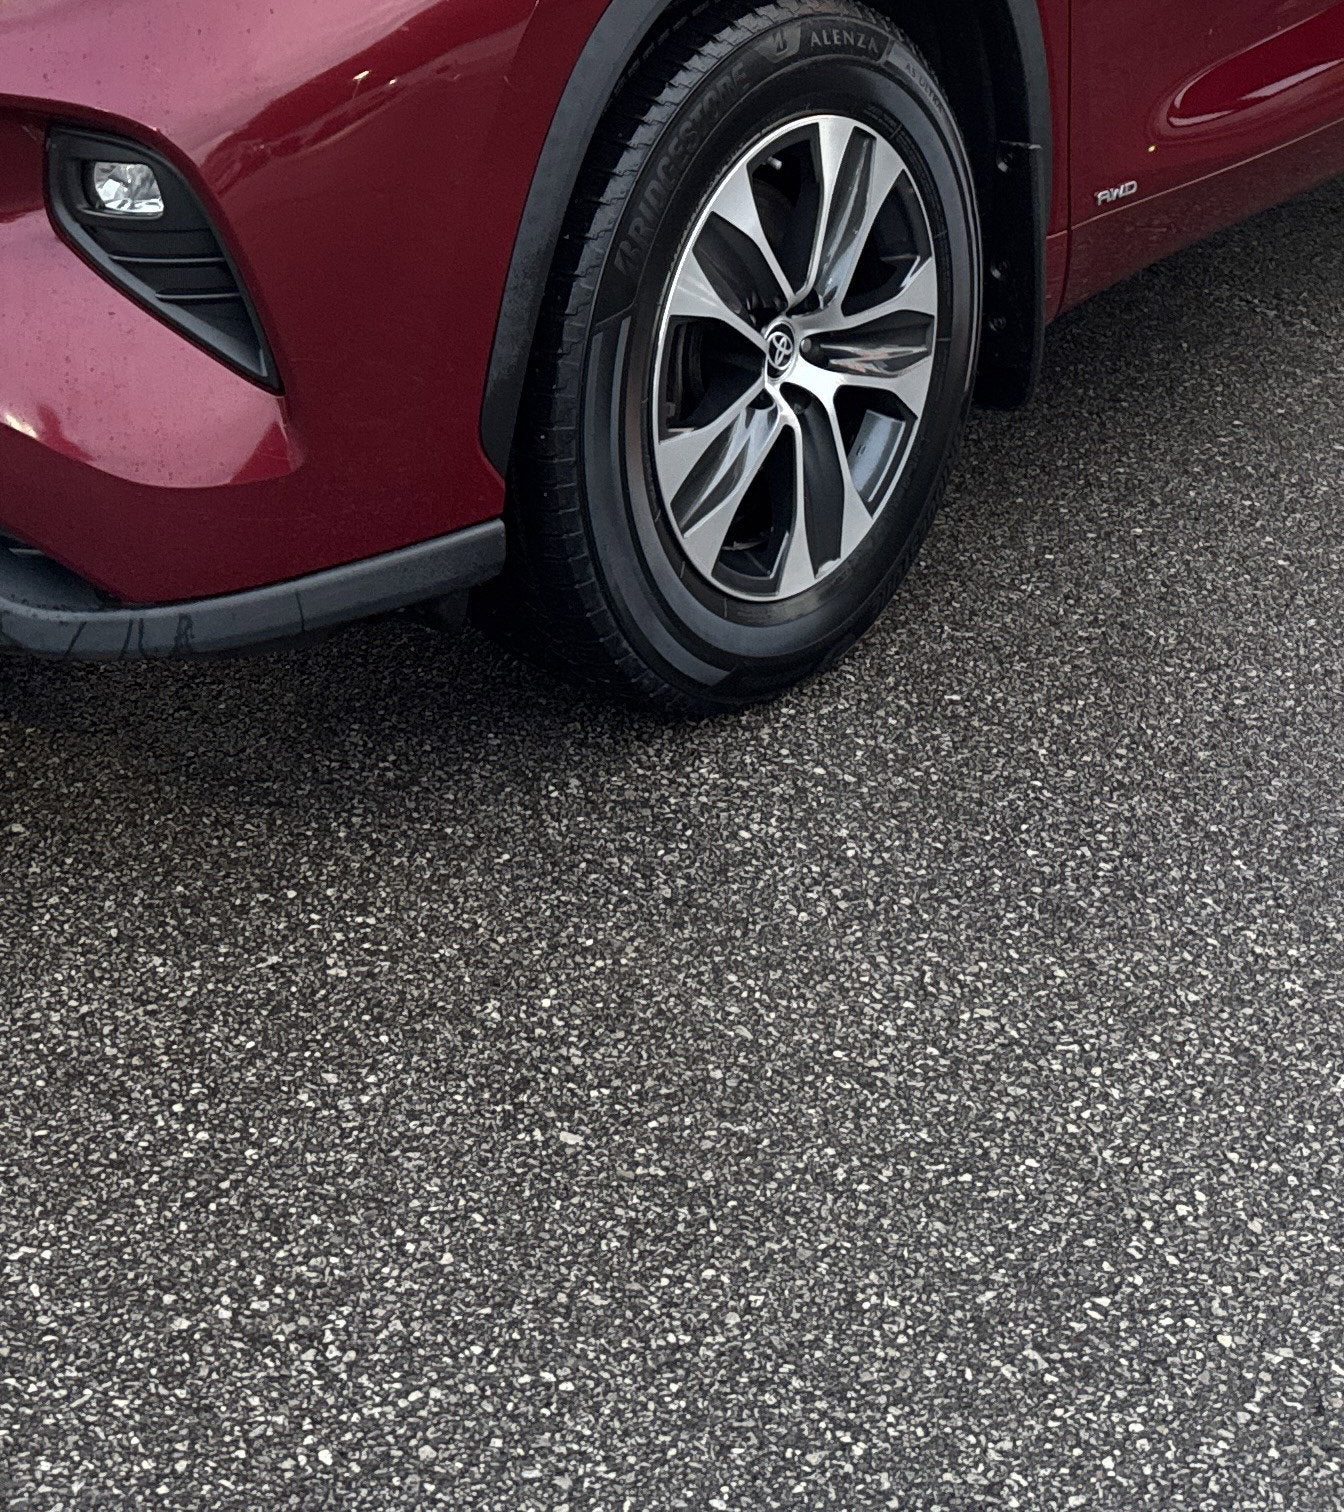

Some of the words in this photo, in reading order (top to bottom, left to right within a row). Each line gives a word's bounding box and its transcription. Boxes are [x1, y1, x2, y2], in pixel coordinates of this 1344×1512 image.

[809, 28, 879, 54] ALENZA
[614, 60, 751, 275] BRIDGESTONE
[1096, 180, 1138, 206] AWD
